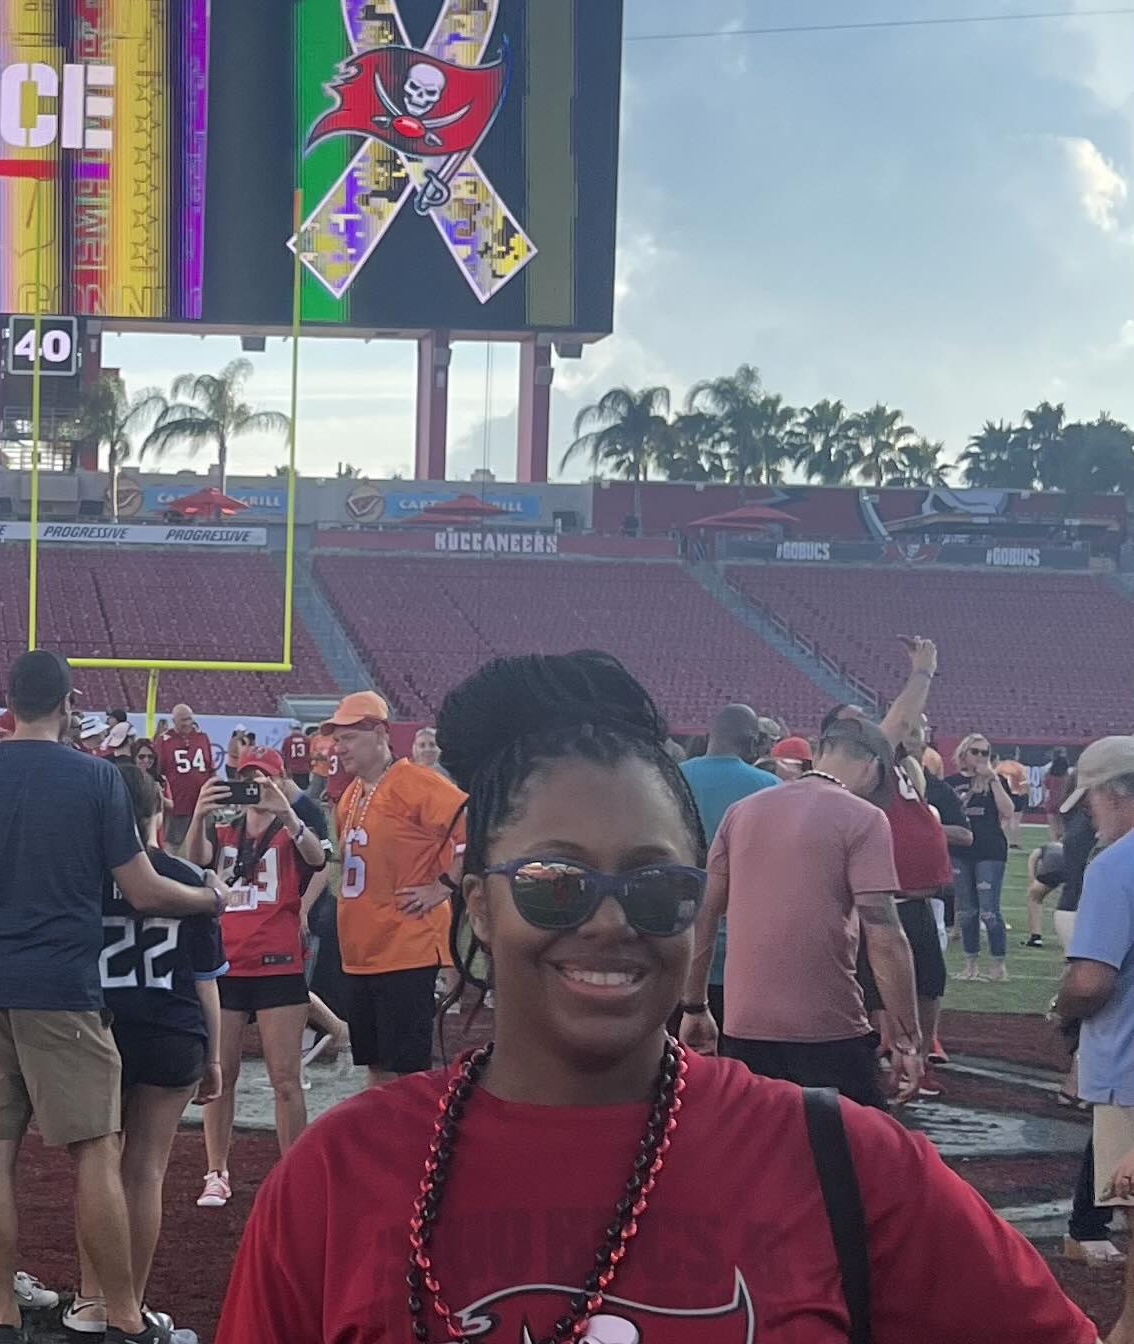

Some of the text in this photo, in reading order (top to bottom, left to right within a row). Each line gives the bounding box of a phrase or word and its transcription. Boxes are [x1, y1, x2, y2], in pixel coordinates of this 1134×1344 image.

[14, 329, 71, 363] 40
[44, 526, 129, 540] PROGRESSIVE
[166, 528, 251, 542] PROGRESSIVE
[434, 531, 558, 554] BUCCANEERS
[776, 541, 830, 561] #GOBUCS
[985, 547, 1040, 567] #GOBUCS
[174, 748, 206, 774] 54
[291, 743, 305, 758] 13
[341, 828, 368, 898] 6
[98, 916, 182, 990] 22
